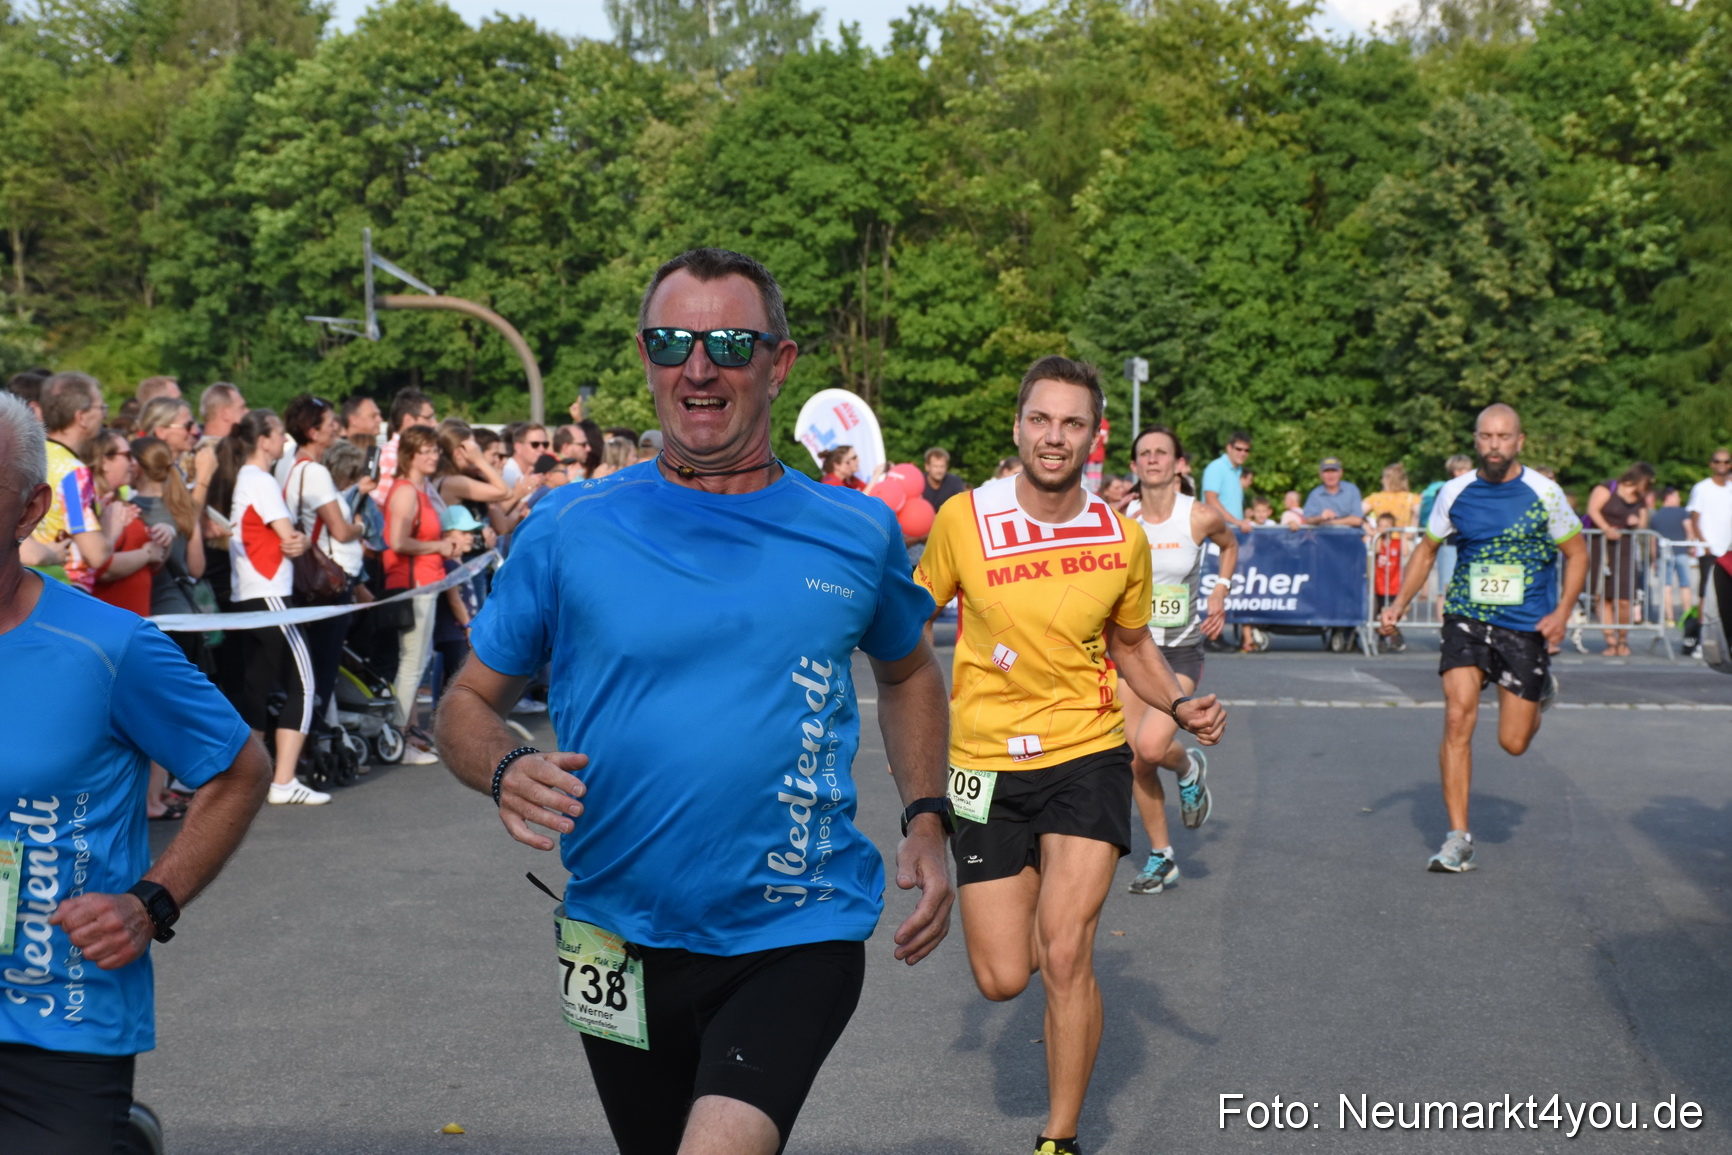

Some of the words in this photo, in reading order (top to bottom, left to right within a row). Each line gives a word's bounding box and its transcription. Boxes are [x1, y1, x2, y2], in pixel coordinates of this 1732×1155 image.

[986, 560, 1054, 588] MAX
[1060, 550, 1128, 575] BÖGL
[804, 577, 855, 600] Werner
[1200, 566, 1310, 596] scher
[1480, 578, 1510, 593] 237
[1151, 599, 1181, 615] 159
[558, 956, 628, 1012] 738
[577, 1003, 614, 1020] Werner
